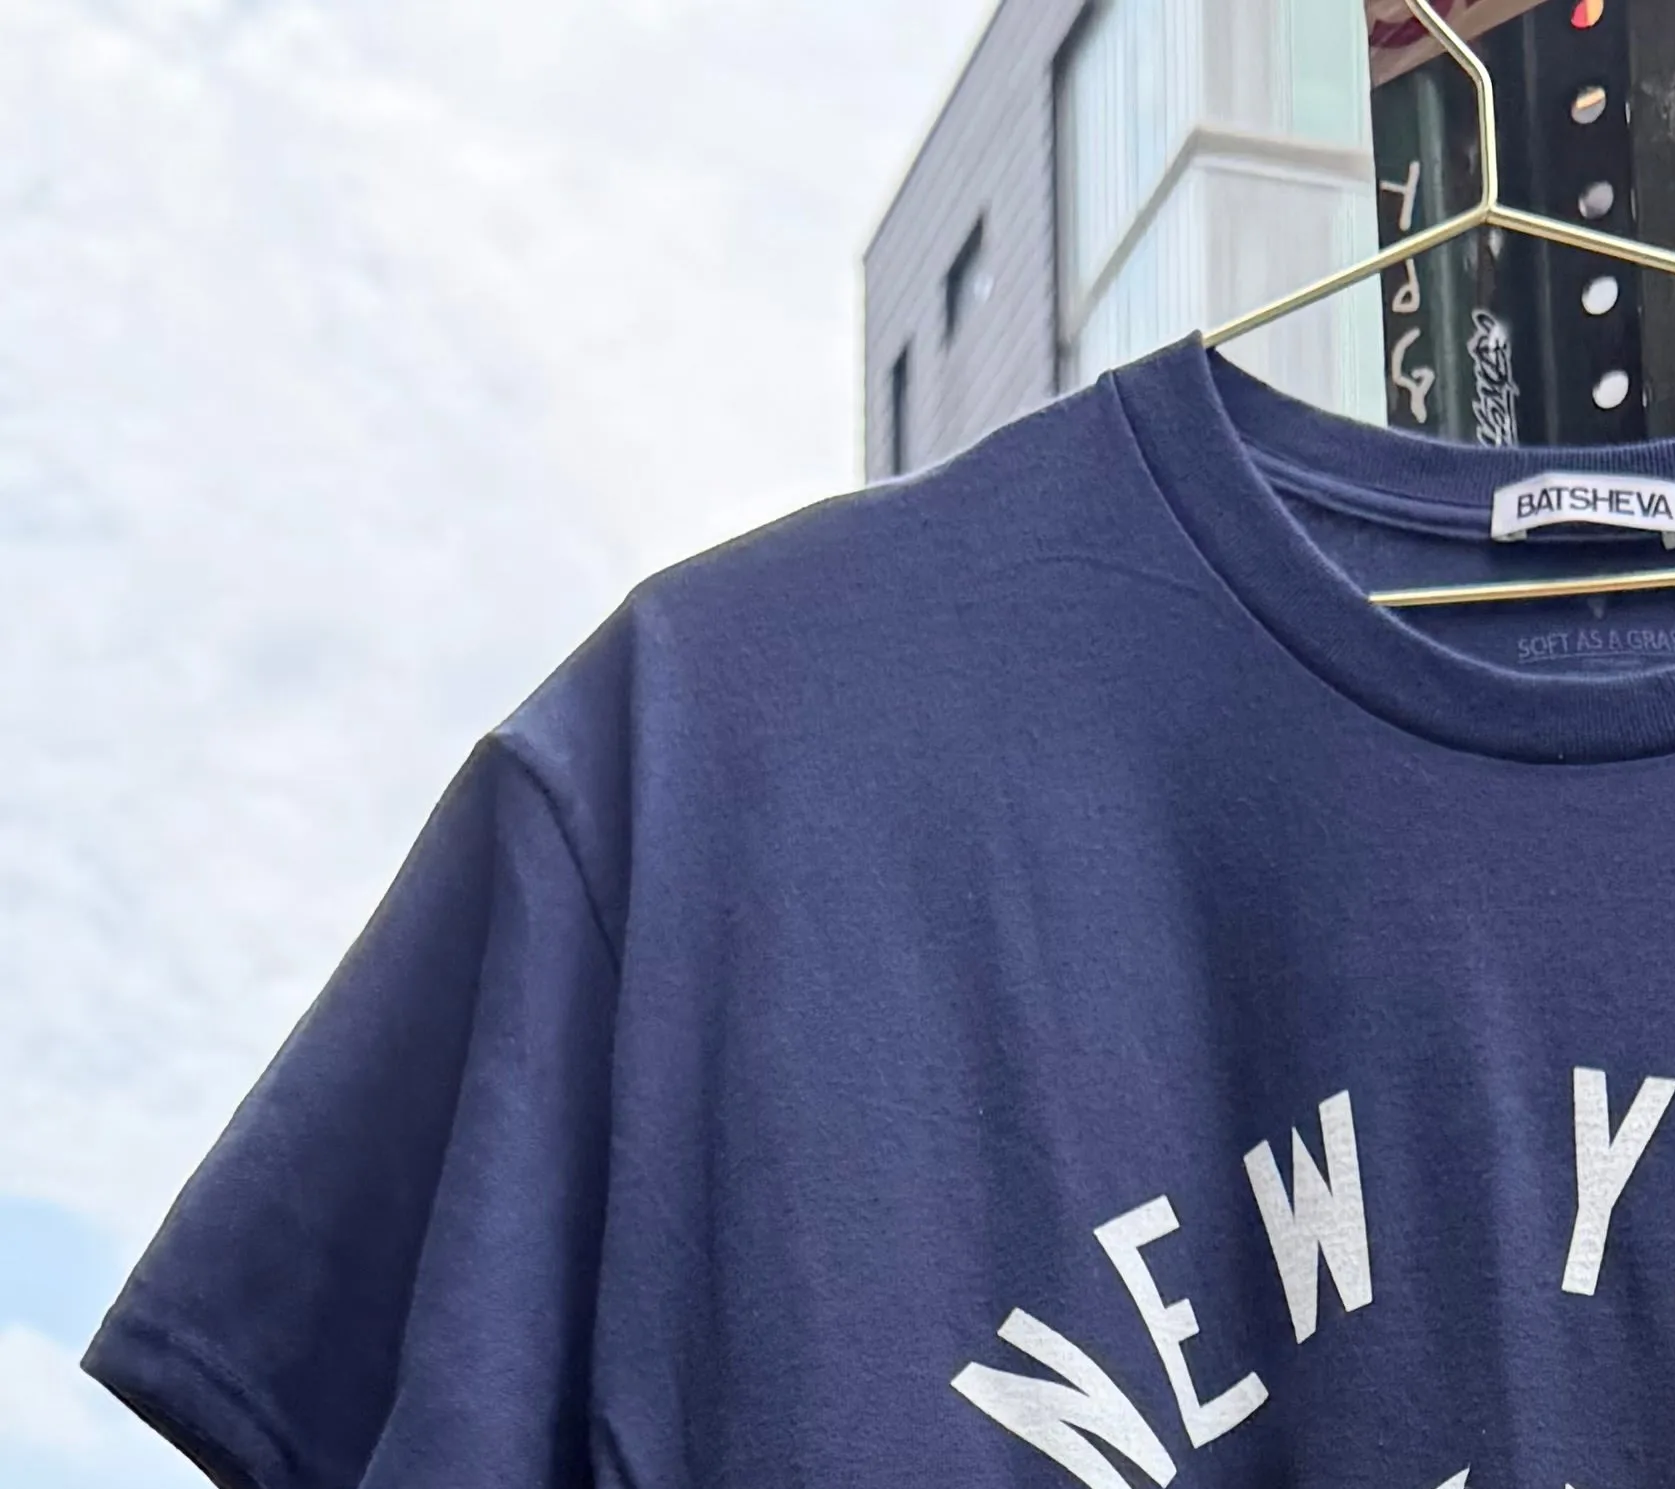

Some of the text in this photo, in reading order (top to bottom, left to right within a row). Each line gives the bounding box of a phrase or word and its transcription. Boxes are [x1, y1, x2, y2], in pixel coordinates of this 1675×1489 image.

[1517, 486, 1673, 520] BATSHEVA
[1518, 632, 1569, 659] SOFT
[1577, 629, 1603, 651] AS
[1609, 629, 1625, 650] A
